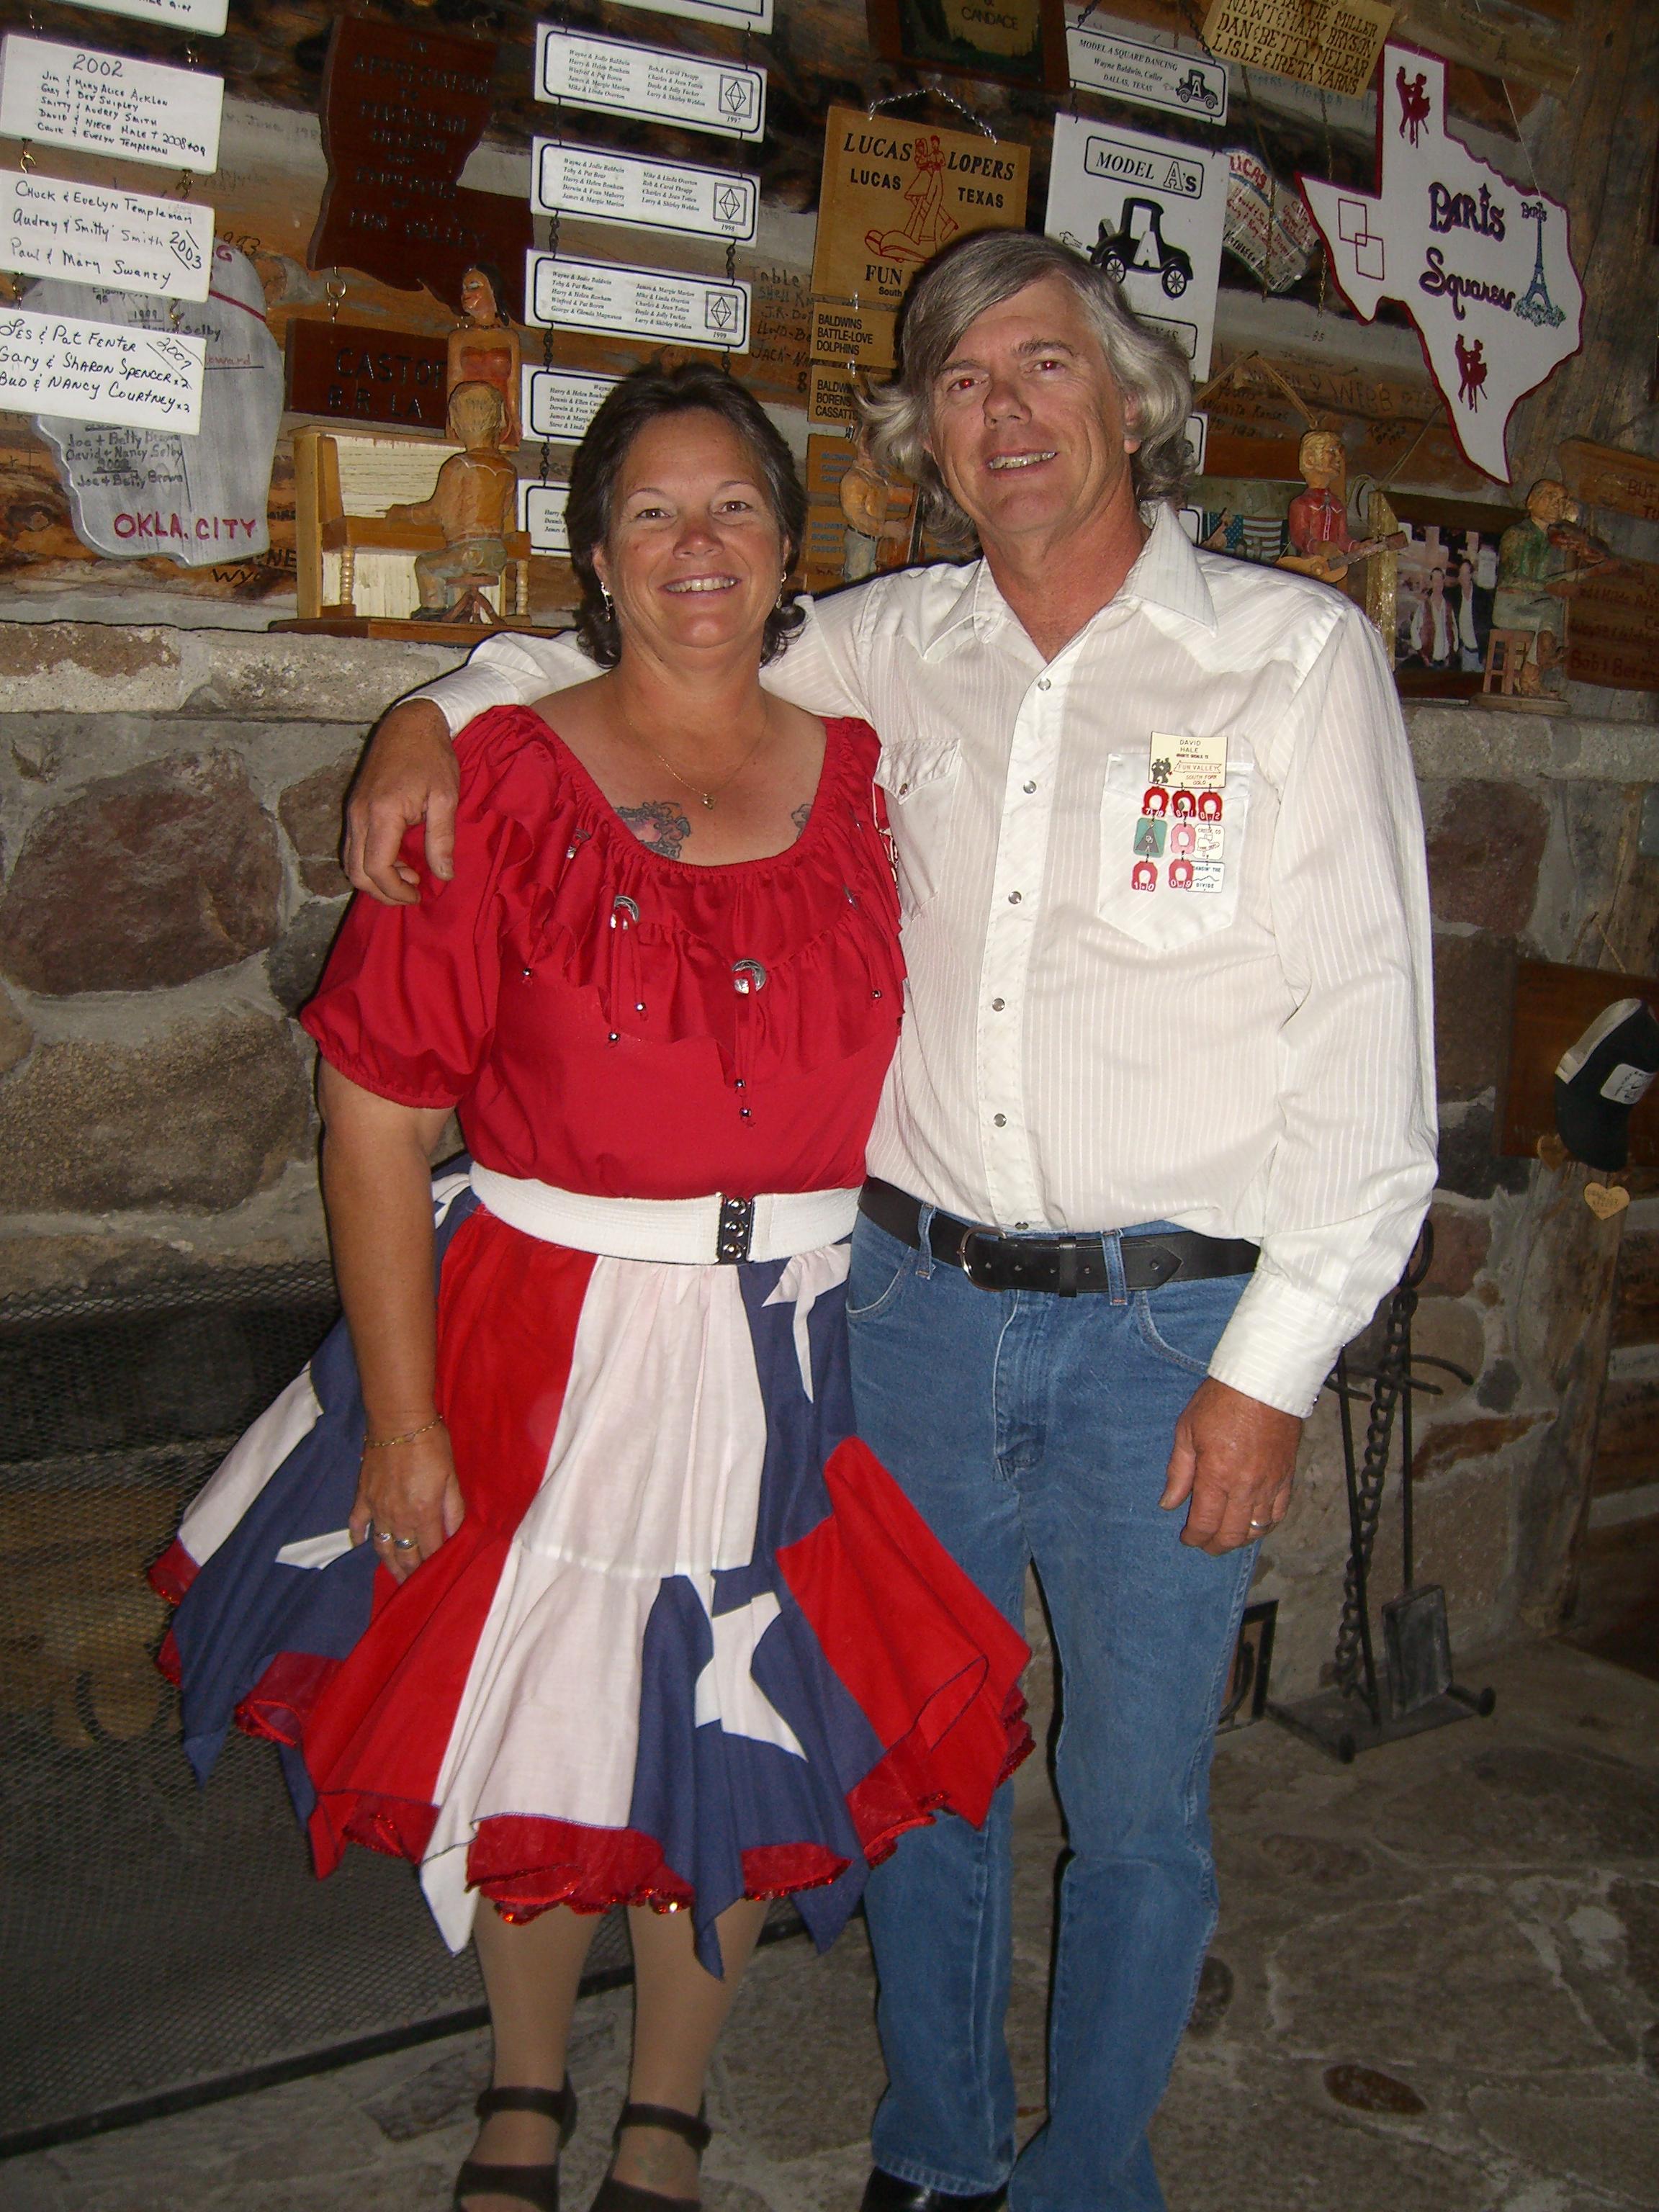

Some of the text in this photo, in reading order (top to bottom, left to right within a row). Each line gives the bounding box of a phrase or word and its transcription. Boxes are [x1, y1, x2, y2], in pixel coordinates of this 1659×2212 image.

[1216, 12, 1254, 40] DAN
[1257, 26, 1312, 58] BETTY
[1282, 10, 1328, 41] MARY
[1326, 27, 1376, 58] BRYSON
[1334, 11, 1377, 37] MILLER
[73, 54, 123, 78] 2002
[1079, 39, 1106, 53] MODEL
[1115, 48, 1143, 62] SQUARE
[1145, 57, 1178, 71] DANCING
[1094, 57, 1115, 70] Wayne
[1212, 32, 1262, 64] LISLE
[1318, 66, 1359, 95] YARNS
[1132, 81, 1152, 92] TEXAS
[842, 132, 1015, 181] LUCAS LOPERS
[1096, 152, 1154, 179] MODEL
[850, 168, 1004, 209] LUCAS TEXAS
[13, 209, 58, 233] Audrey
[121, 230, 163, 247] Smith
[11, 237, 40, 261] Paul
[63, 250, 101, 274] Mary
[169, 231, 202, 269] 2003
[865, 264, 902, 286] FUN
[878, 286, 902, 297] South
[53, 325, 82, 346] Pat
[817, 326, 873, 345] BATTLE-LOVE
[818, 314, 863, 331] BALDWINS
[0, 346, 39, 371] Gary
[156, 338, 192, 370] 2007
[817, 340, 860, 356] DOLPHINS
[114, 511, 257, 541] OKLA. CITY
